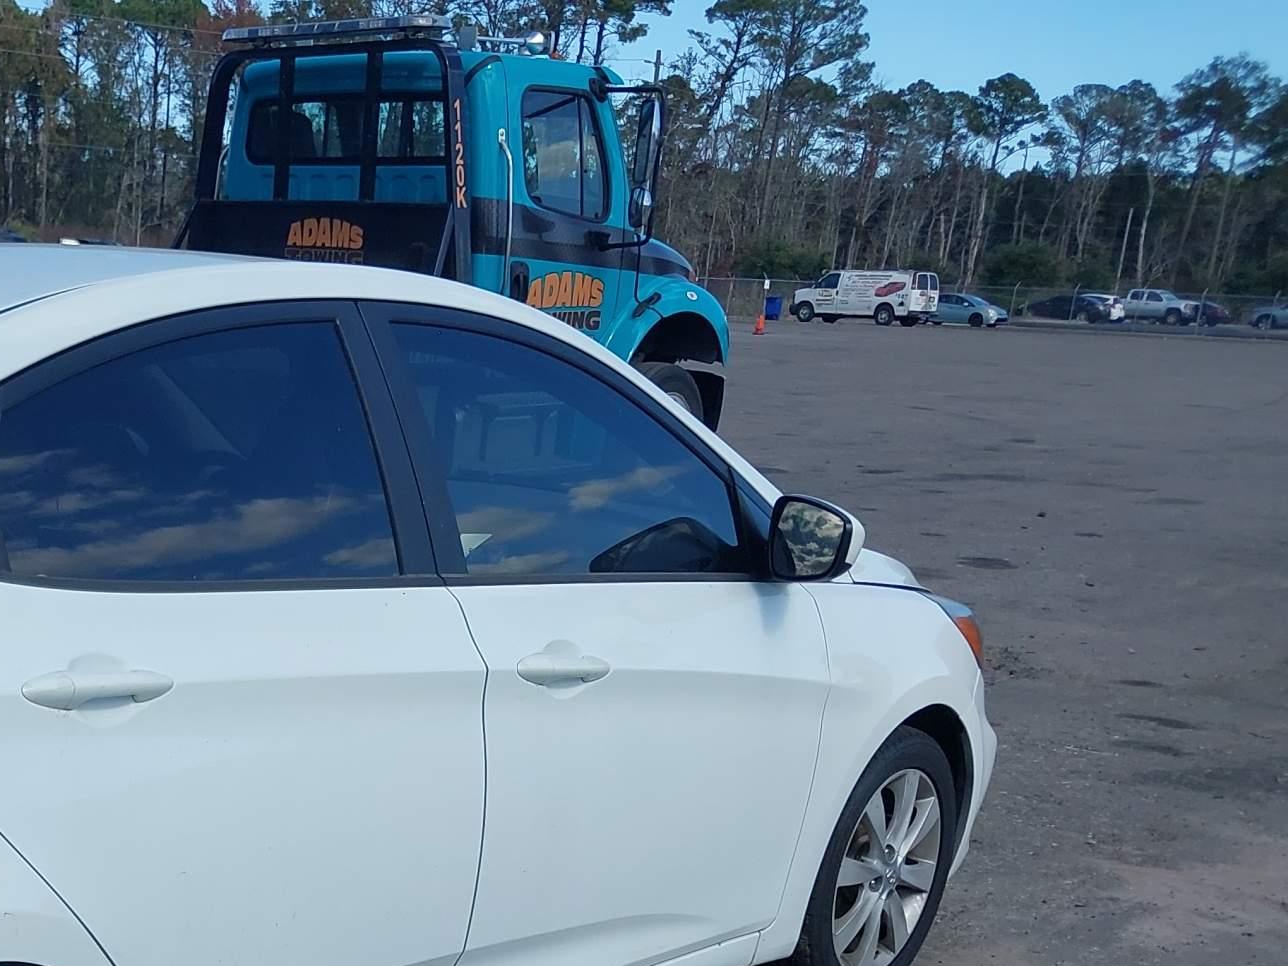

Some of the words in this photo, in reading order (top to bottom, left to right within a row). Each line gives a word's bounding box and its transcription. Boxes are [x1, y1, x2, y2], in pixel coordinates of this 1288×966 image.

[454, 98, 468, 209] 1120K
[287, 217, 364, 250] ADAMS
[526, 271, 604, 308] ADAMS
